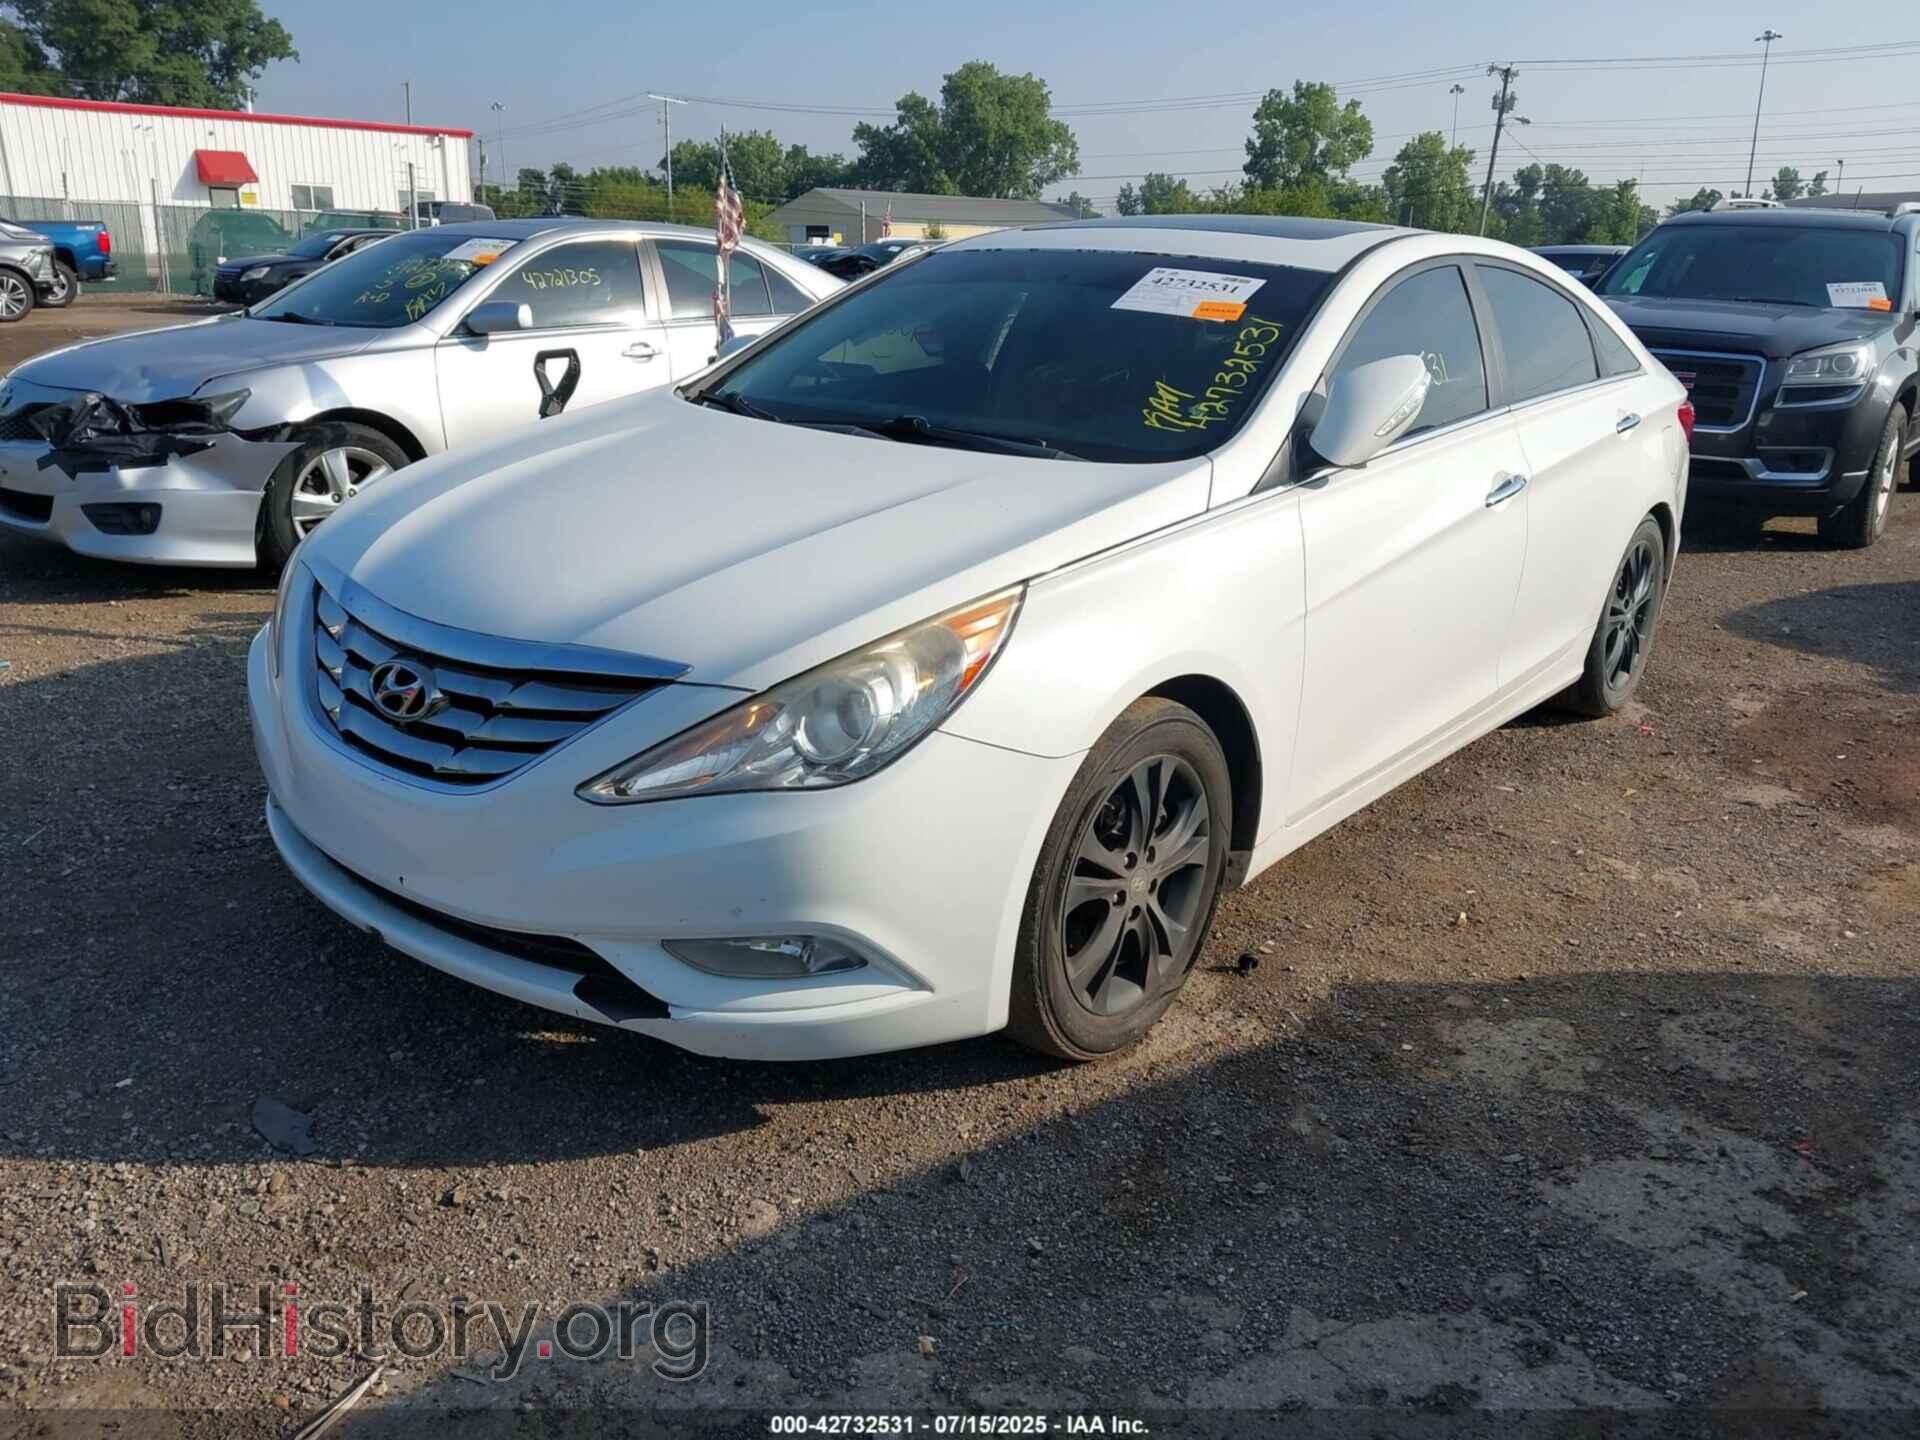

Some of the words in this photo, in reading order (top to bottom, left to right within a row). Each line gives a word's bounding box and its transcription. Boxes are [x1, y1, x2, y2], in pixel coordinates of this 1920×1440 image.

[522, 267, 602, 290] 42721305
[1152, 276, 1239, 294] 42732531
[1188, 316, 1284, 429] 42732531
[1420, 350, 1448, 386] 31
